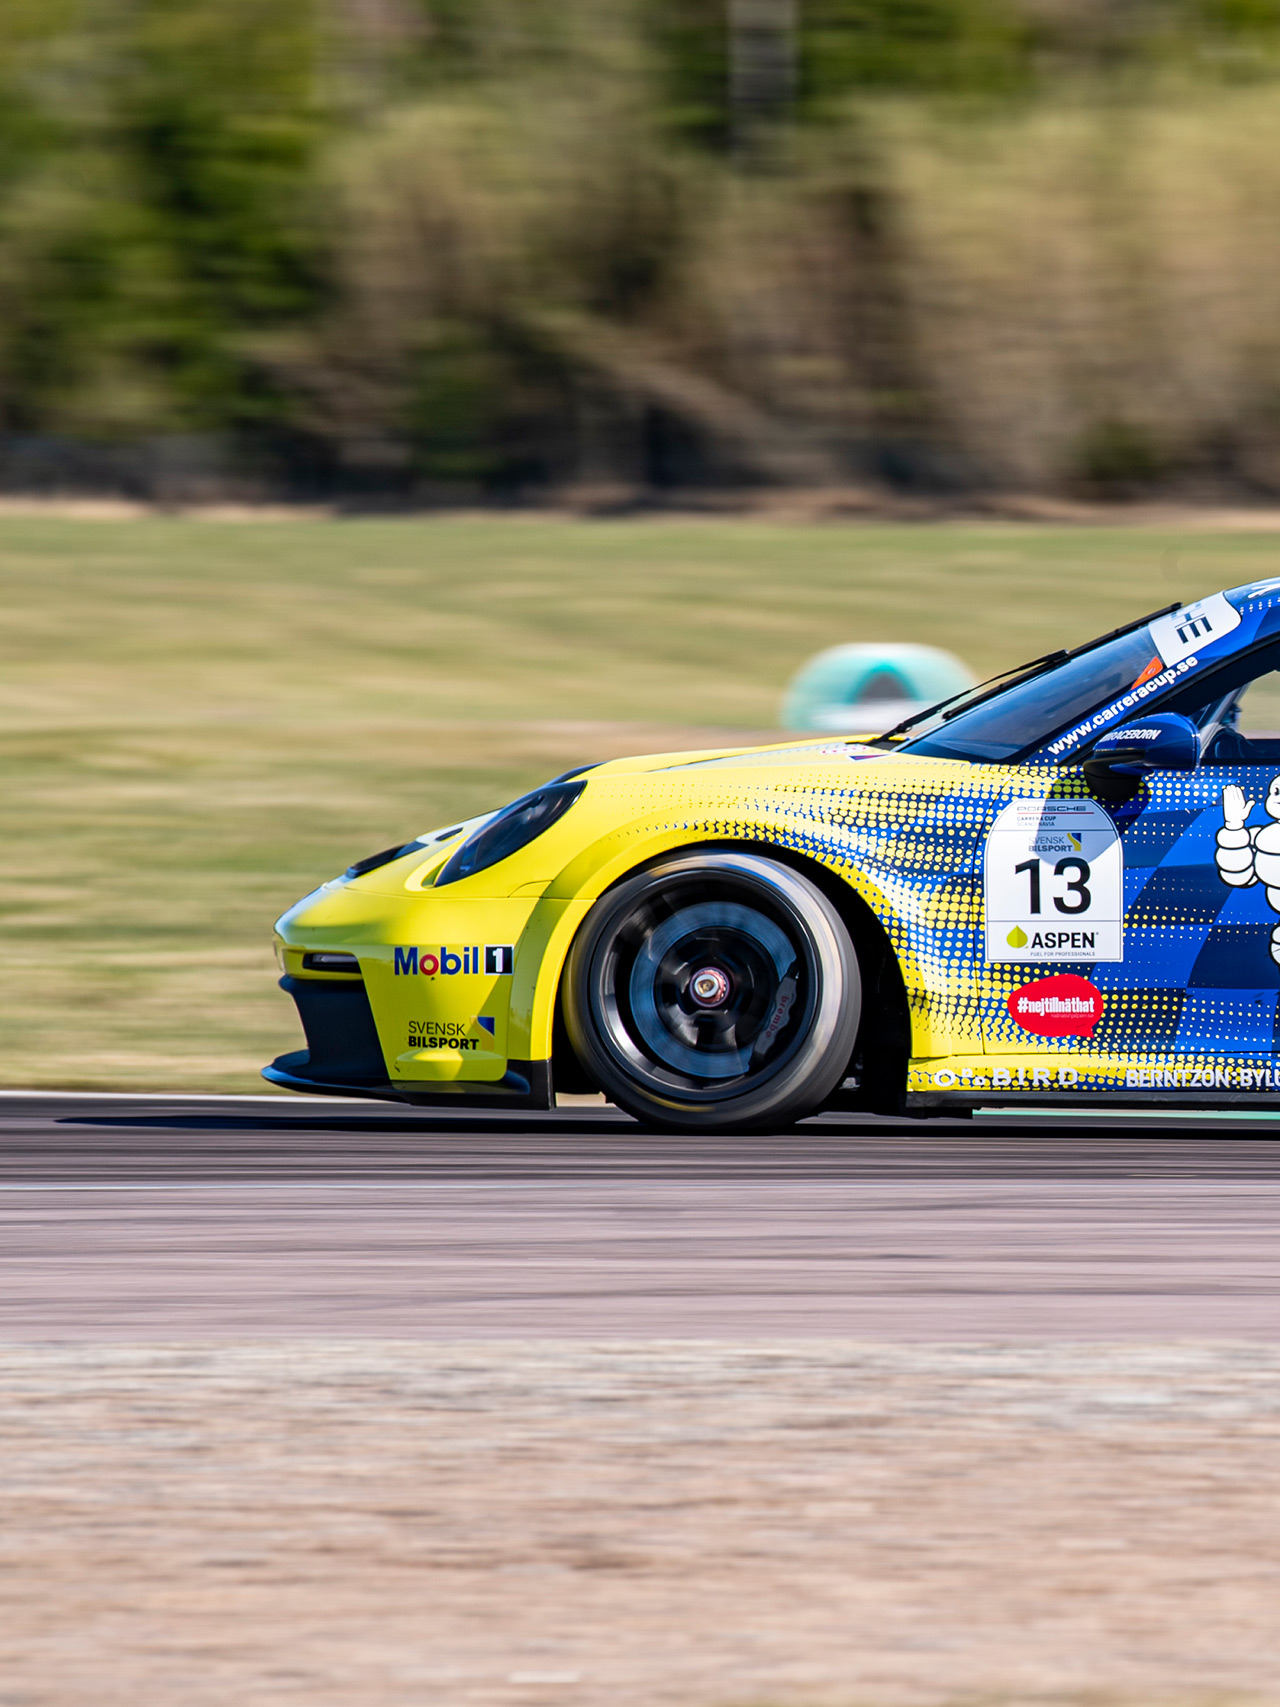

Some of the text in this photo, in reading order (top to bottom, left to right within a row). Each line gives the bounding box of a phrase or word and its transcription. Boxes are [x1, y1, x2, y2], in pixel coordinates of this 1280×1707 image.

[1047, 656, 1198, 756] www.carreracup.se
[1108, 728, 1162, 740] RACEBORN
[1028, 837, 1065, 845] SVENSK
[1028, 845, 1073, 853] BILSPORT
[1014, 856, 1092, 915] 13
[1031, 932, 1096, 949] ASPEN
[394, 946, 479, 975] Mobil
[1017, 996, 1095, 1016] #nejtillnäthat
[765, 995, 790, 1038] brembo
[408, 1020, 466, 1036] SVENSK
[408, 1035, 480, 1050] BILSPORT
